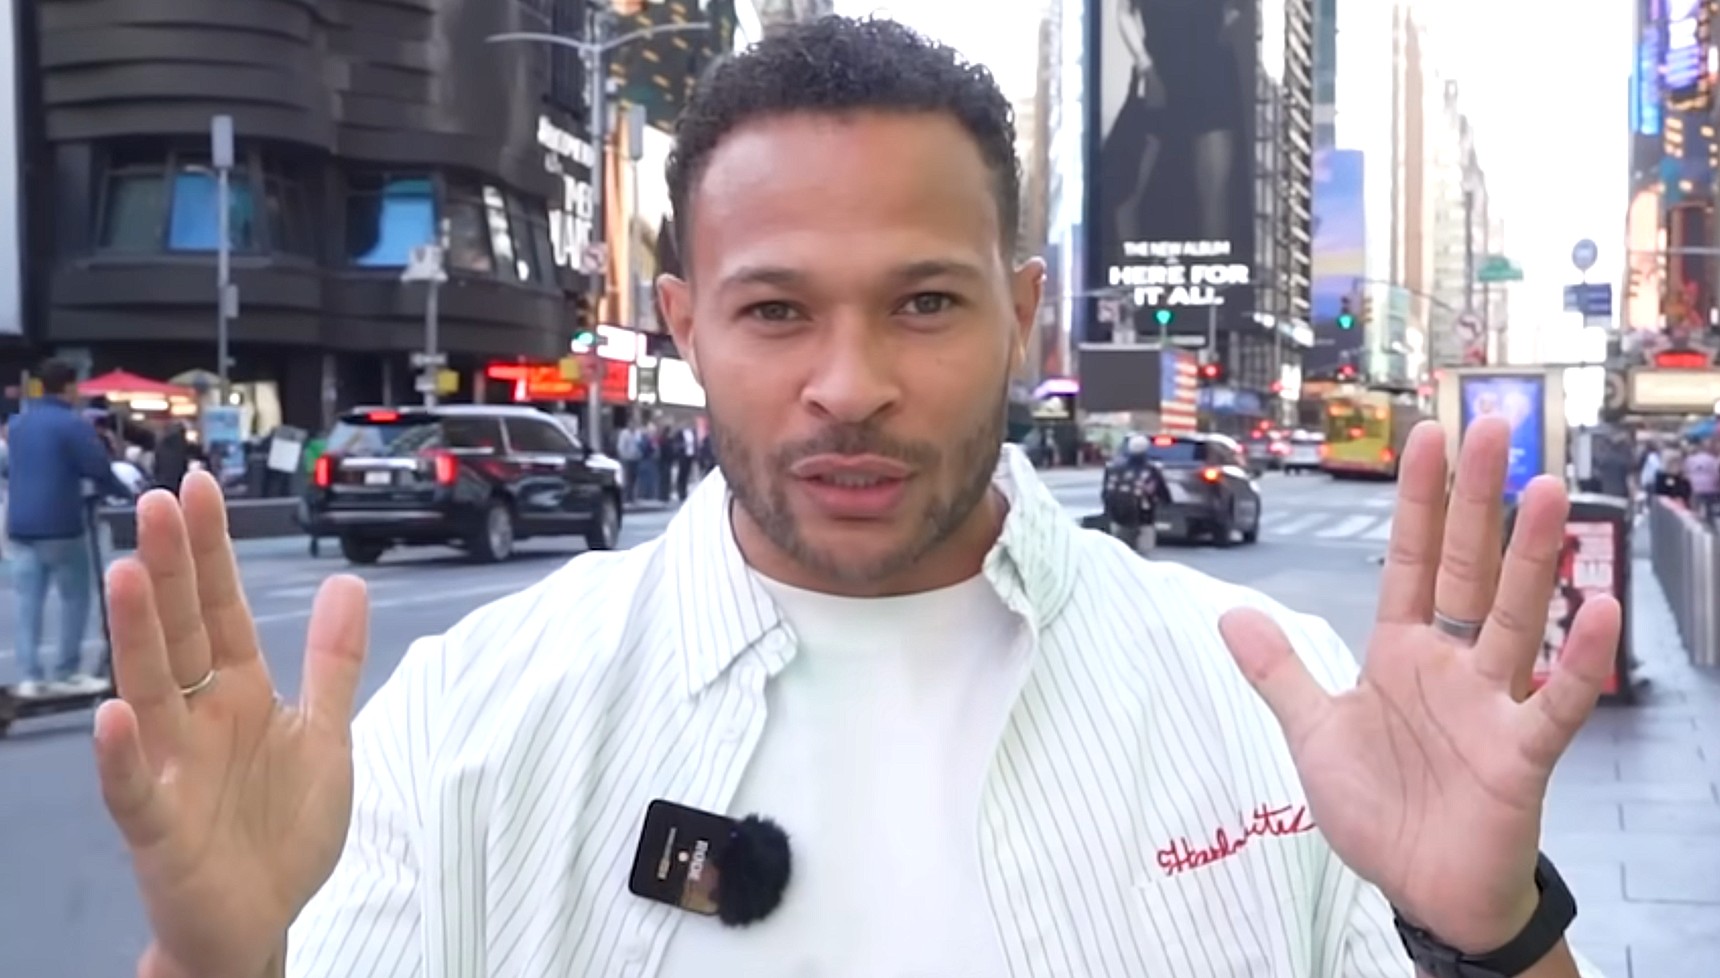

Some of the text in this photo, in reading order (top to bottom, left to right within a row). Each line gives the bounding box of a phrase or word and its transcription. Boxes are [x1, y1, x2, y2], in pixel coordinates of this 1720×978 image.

[1123, 241, 1231, 256] THE NEW ALBUM
[1109, 264, 1249, 285] HERE FOR
[1134, 286, 1164, 306] IT
